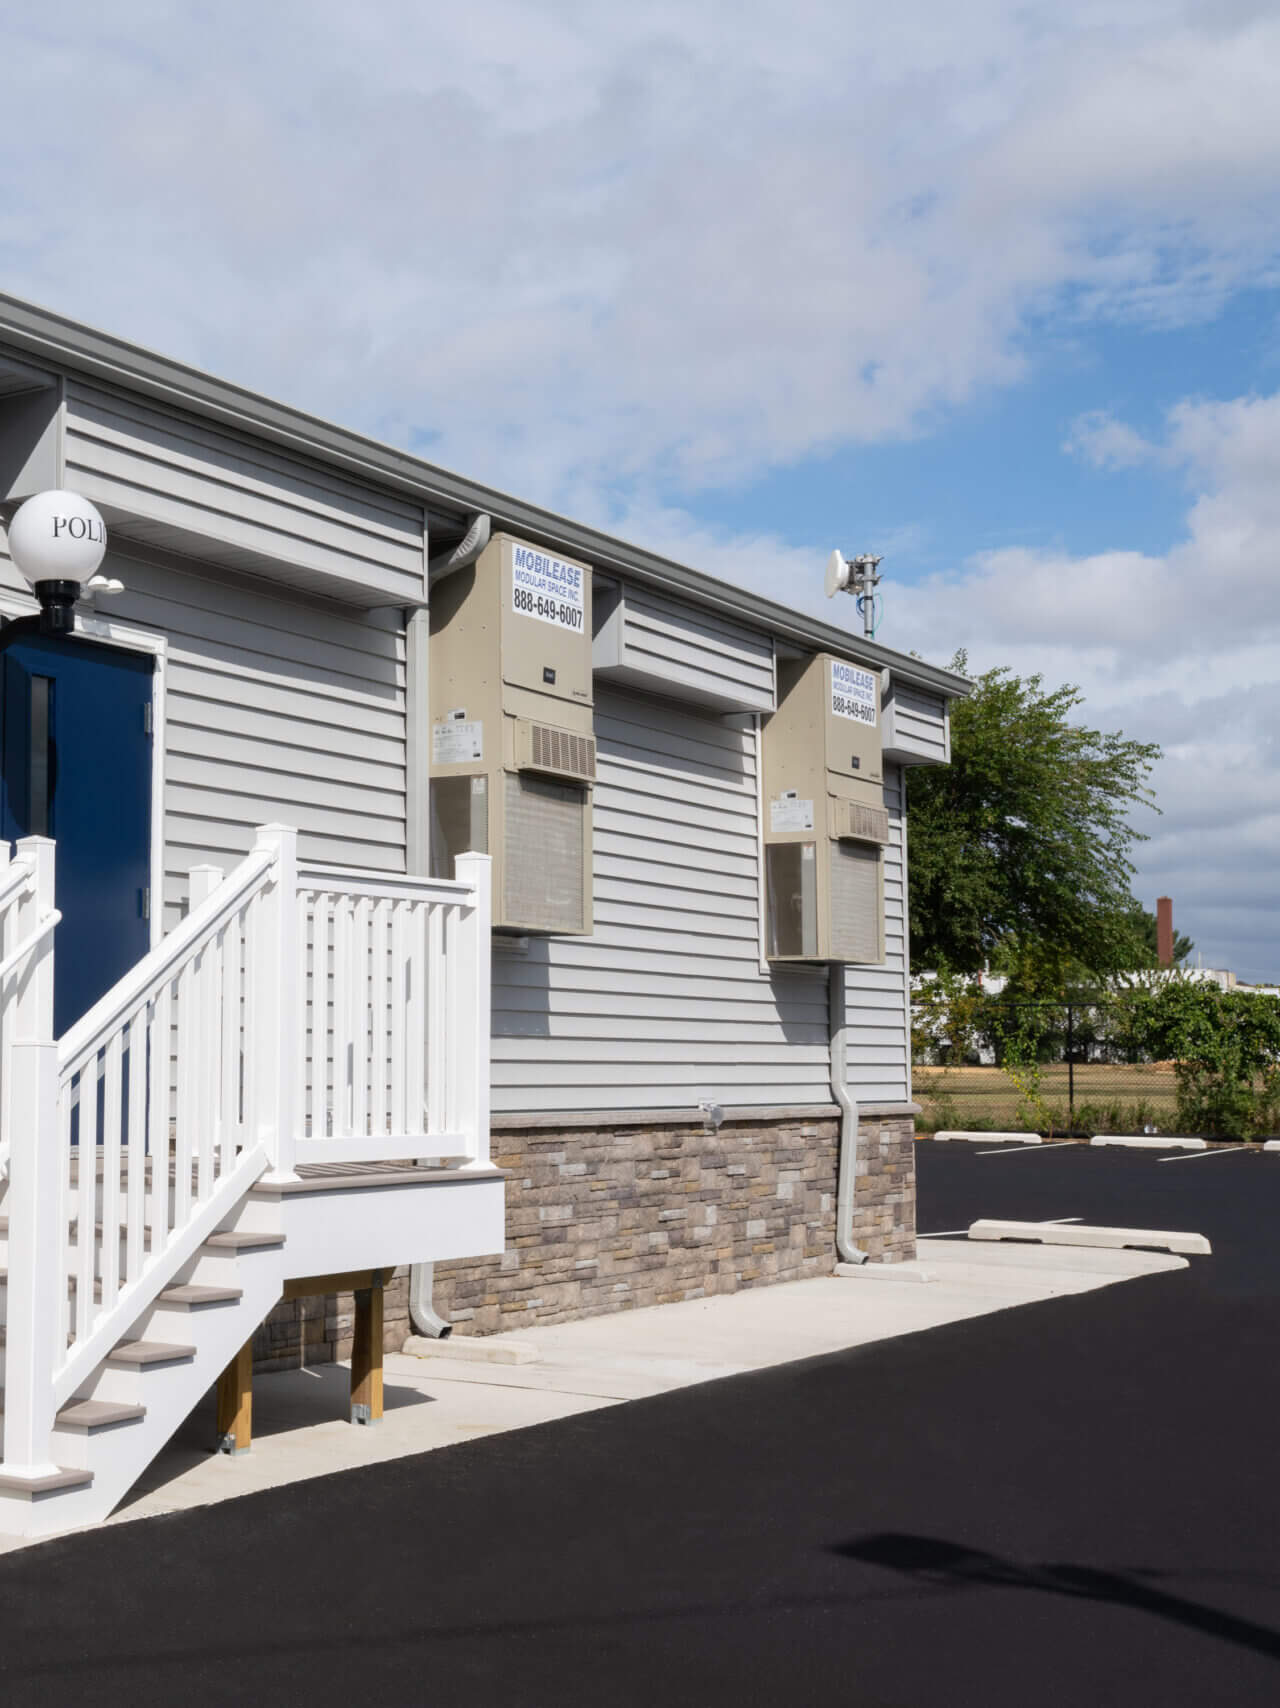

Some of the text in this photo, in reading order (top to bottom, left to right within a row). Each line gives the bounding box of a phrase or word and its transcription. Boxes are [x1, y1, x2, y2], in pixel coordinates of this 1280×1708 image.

[51, 515, 106, 545] POLI
[515, 547, 581, 588] MOBILEASE
[515, 569, 546, 590] MODULAR
[547, 580, 567, 598] SPACE
[514, 588, 583, 629] 888-649-6007
[833, 663, 873, 691] MOBILEASE
[833, 695, 875, 723] 888-649-6007
